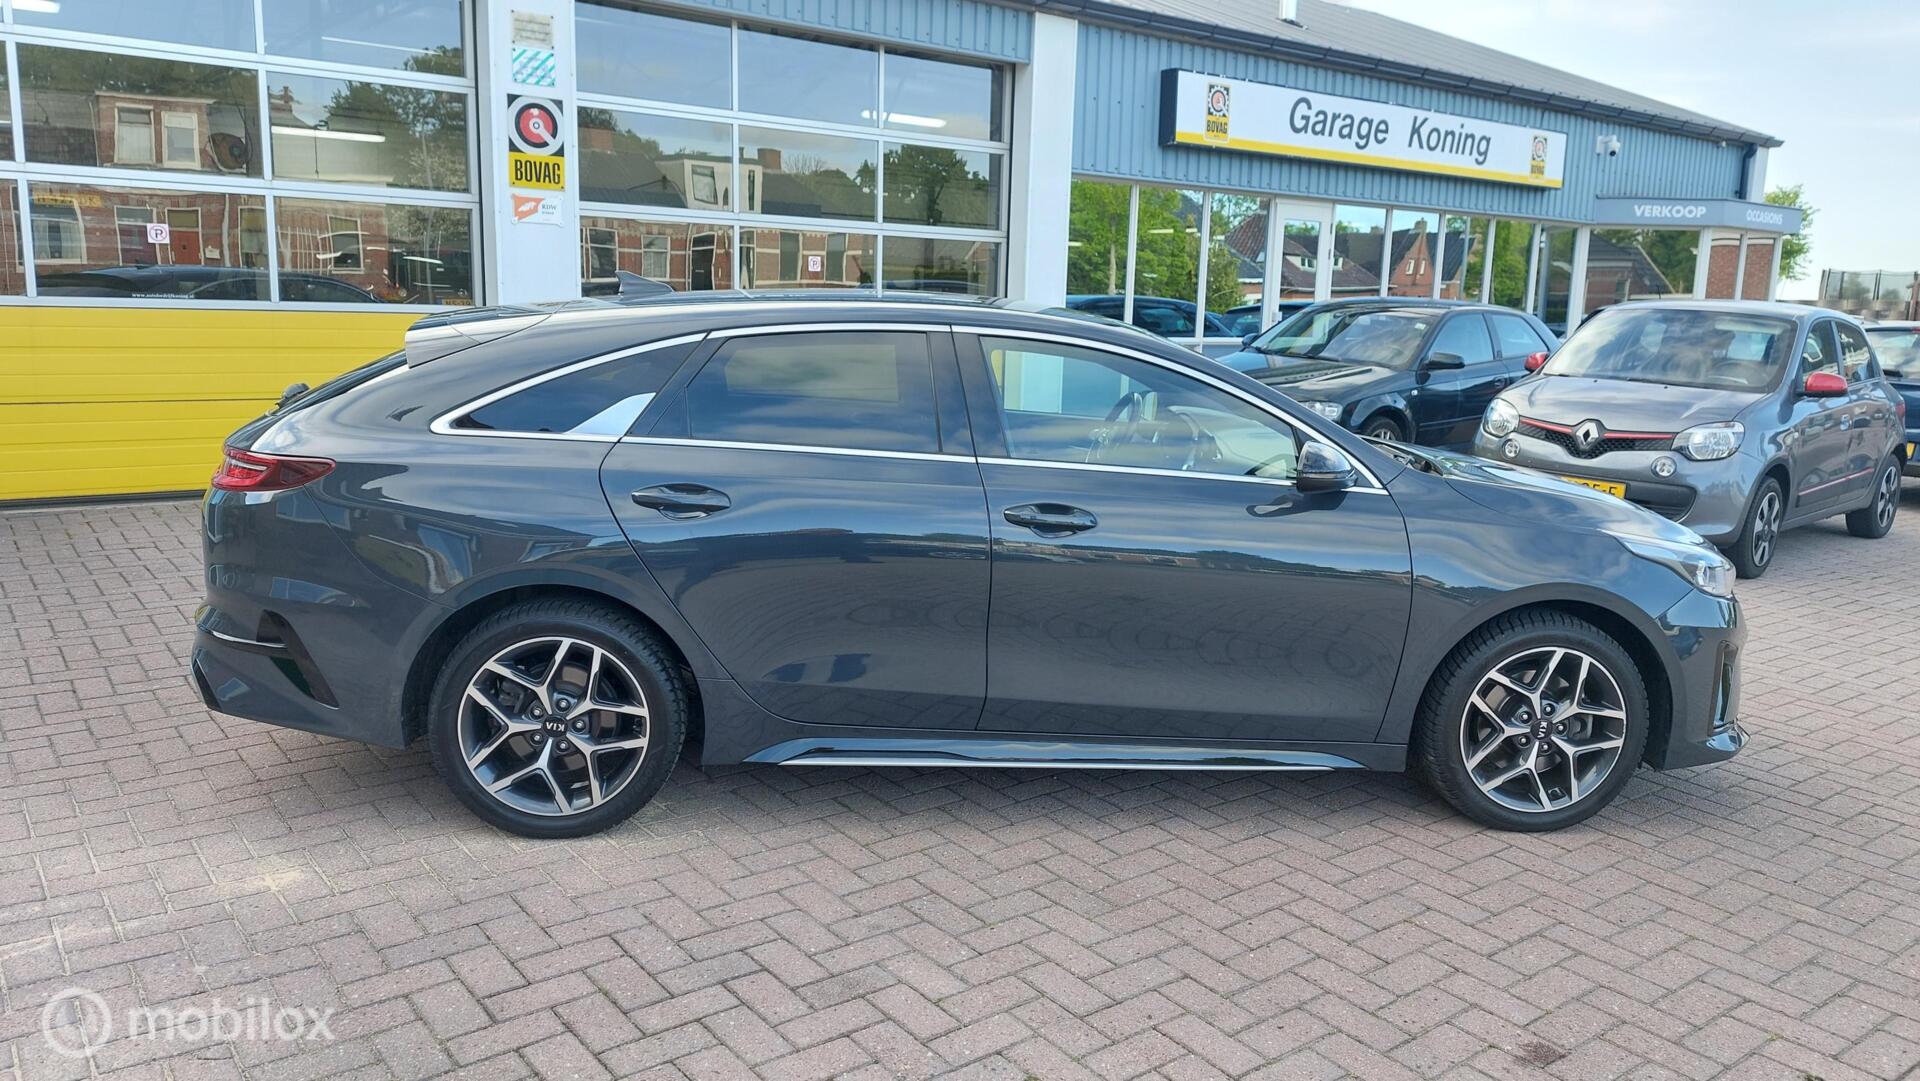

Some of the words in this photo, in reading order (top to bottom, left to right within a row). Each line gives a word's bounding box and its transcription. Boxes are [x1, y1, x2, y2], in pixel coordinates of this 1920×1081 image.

[1206, 119, 1228, 134] BOVAG
[1289, 96, 1389, 150] Garage
[1408, 115, 1492, 166] Koning
[514, 159, 561, 184] BOVAG
[1634, 205, 1706, 218] VERKOOP
[1746, 209, 1783, 225] OCCASIONS
[545, 721, 566, 731] KIA
[1537, 721, 1548, 738] KIA
